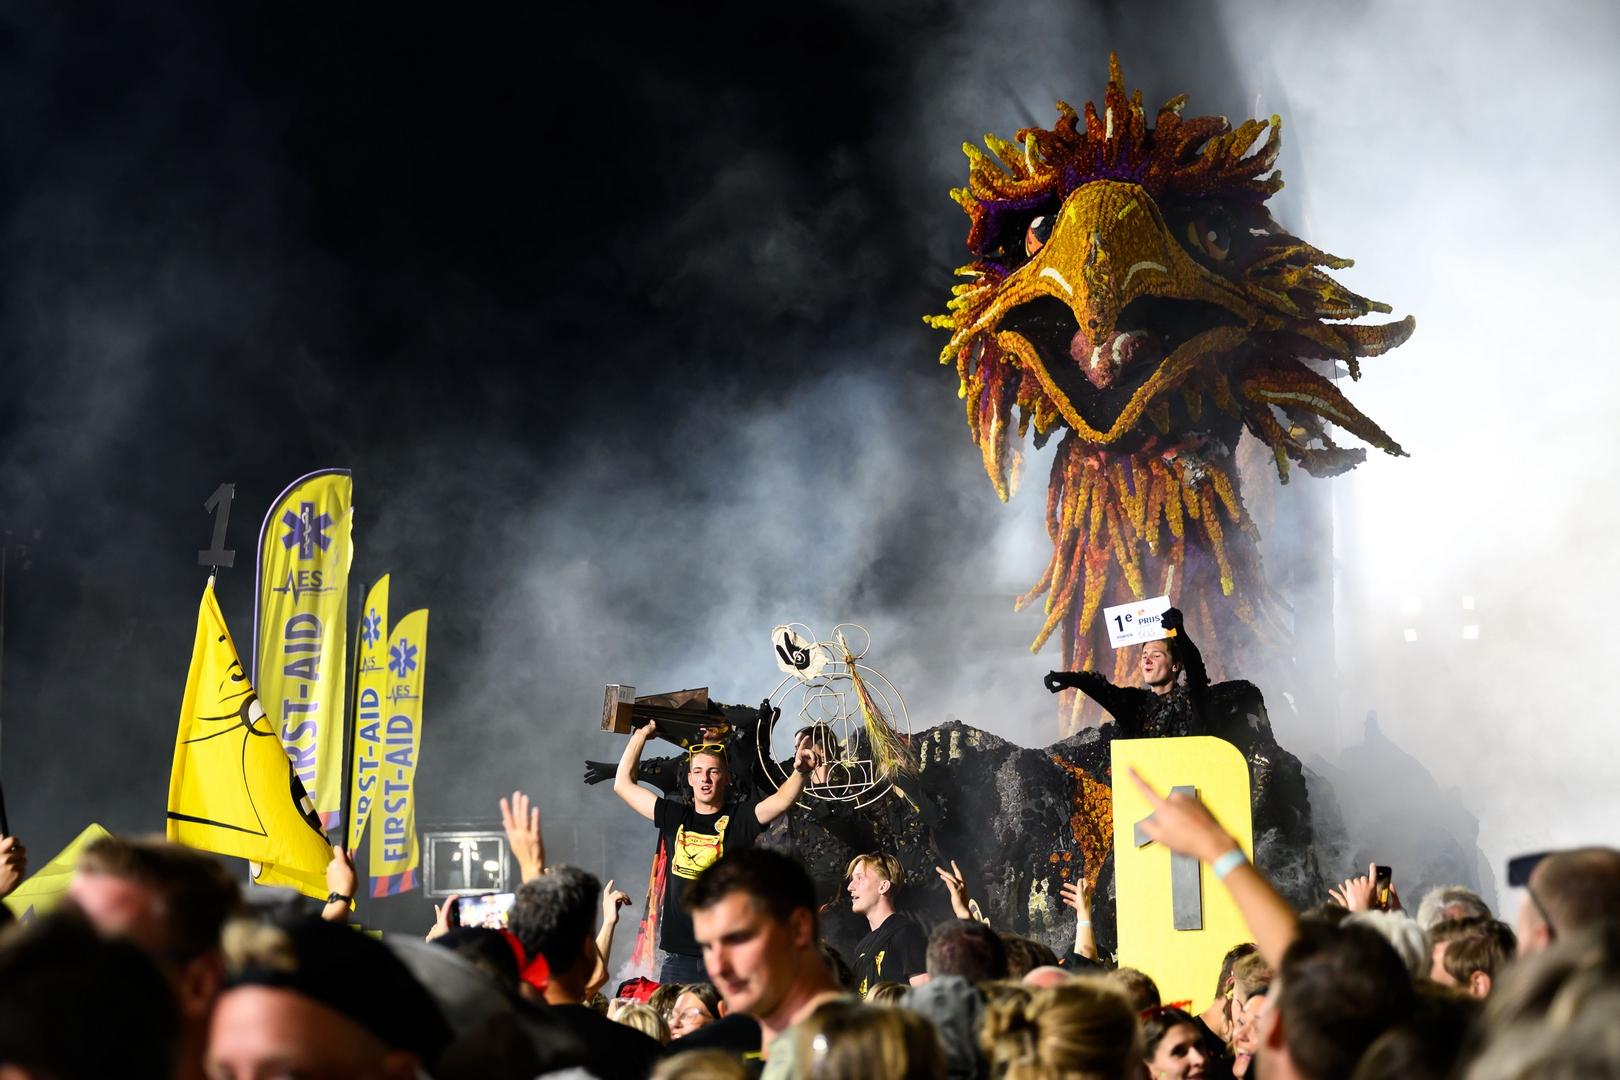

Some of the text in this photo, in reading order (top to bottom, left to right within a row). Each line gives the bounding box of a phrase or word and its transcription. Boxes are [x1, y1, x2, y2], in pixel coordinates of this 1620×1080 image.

[198, 483, 236, 568] 1
[1138, 615, 1160, 625] PRIJS
[383, 714, 413, 862] FIRST-AID
